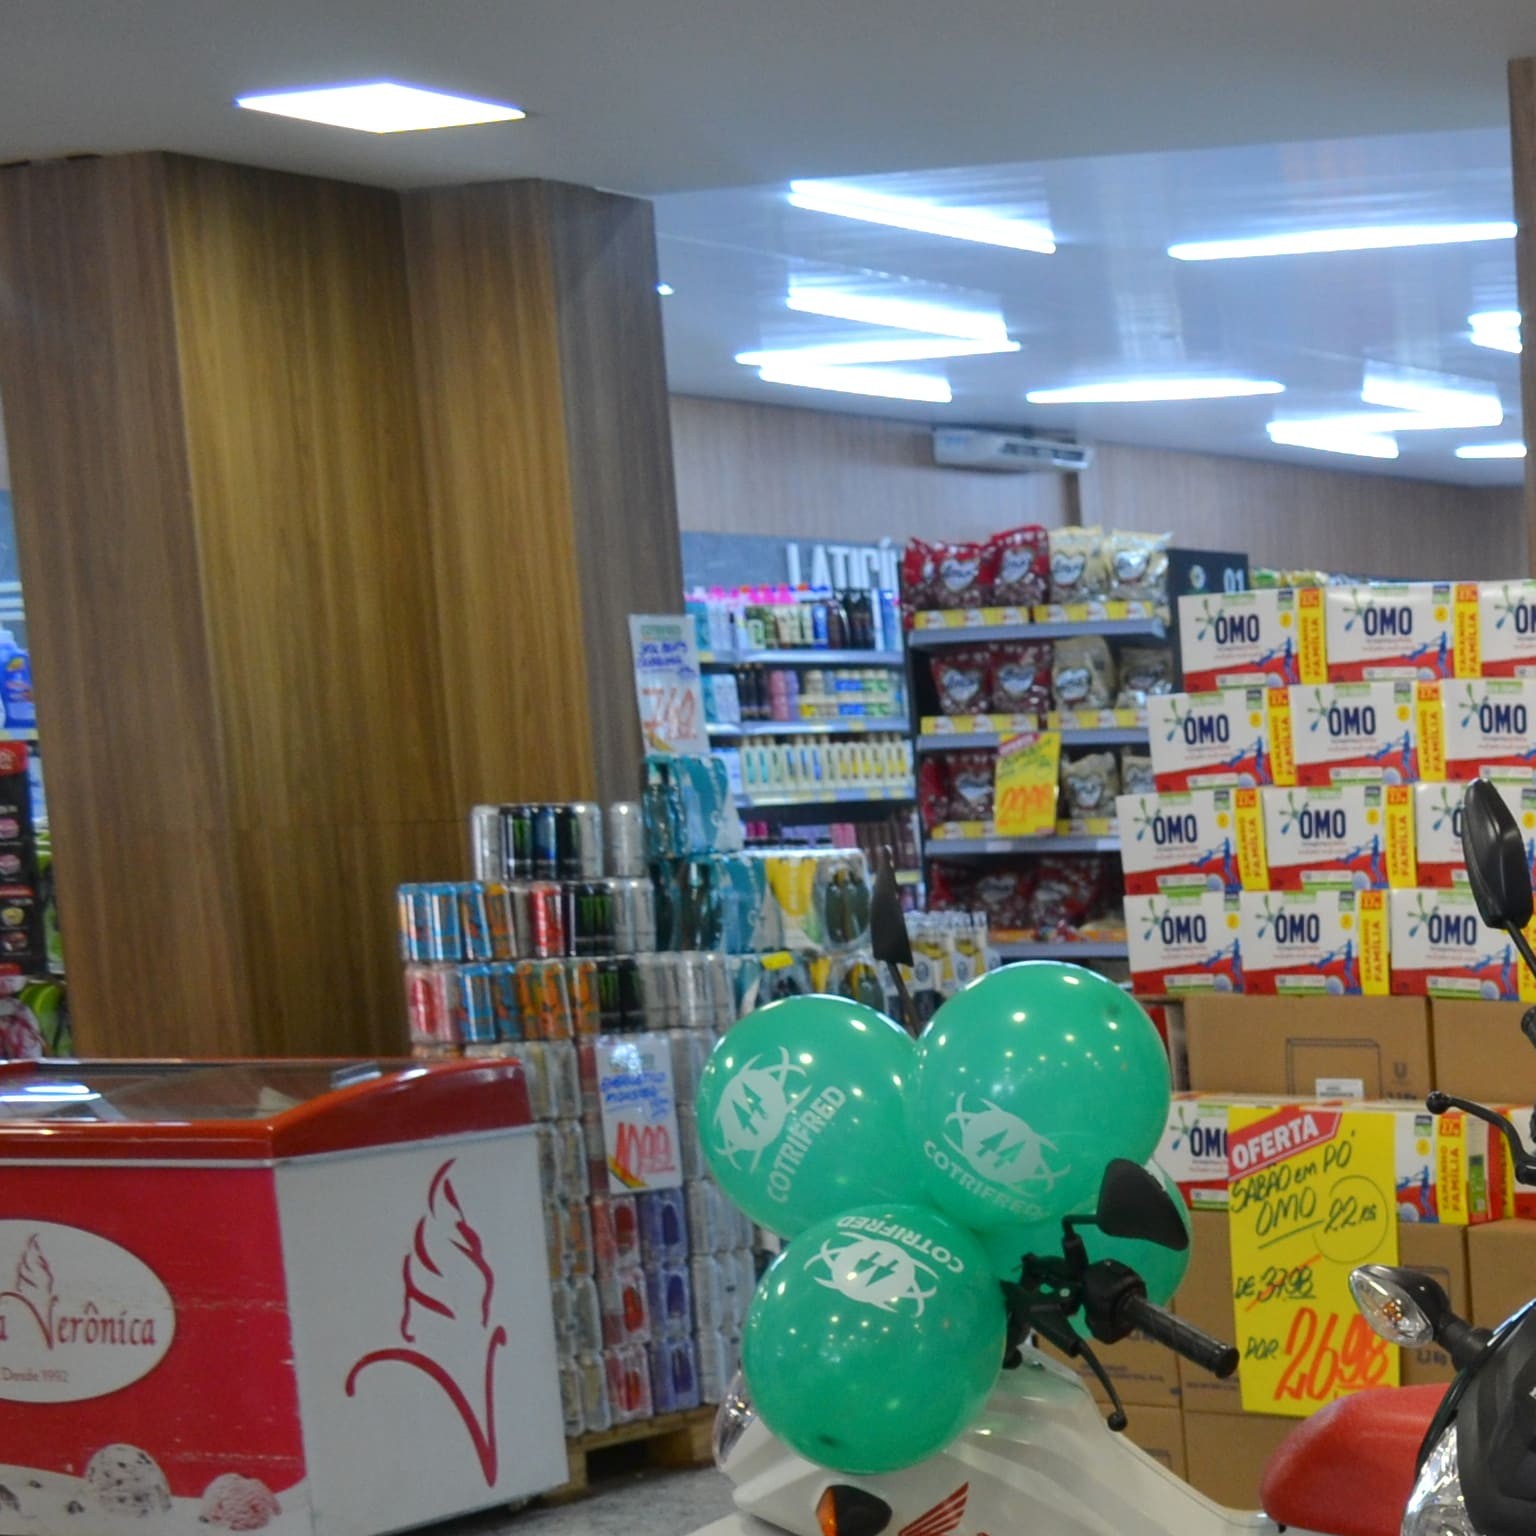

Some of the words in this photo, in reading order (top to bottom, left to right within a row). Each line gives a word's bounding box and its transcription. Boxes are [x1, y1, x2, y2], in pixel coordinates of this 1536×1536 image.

[766, 1085, 847, 1203] COTRIFRED
[1231, 1113, 1321, 1170] OFERTA
[923, 1140, 1043, 1219] COTRIFRED
[1255, 1187, 1317, 1237] OMO
[837, 1216, 964, 1274] COTRIFRED
[0, 1292, 157, 1351] Verônica
